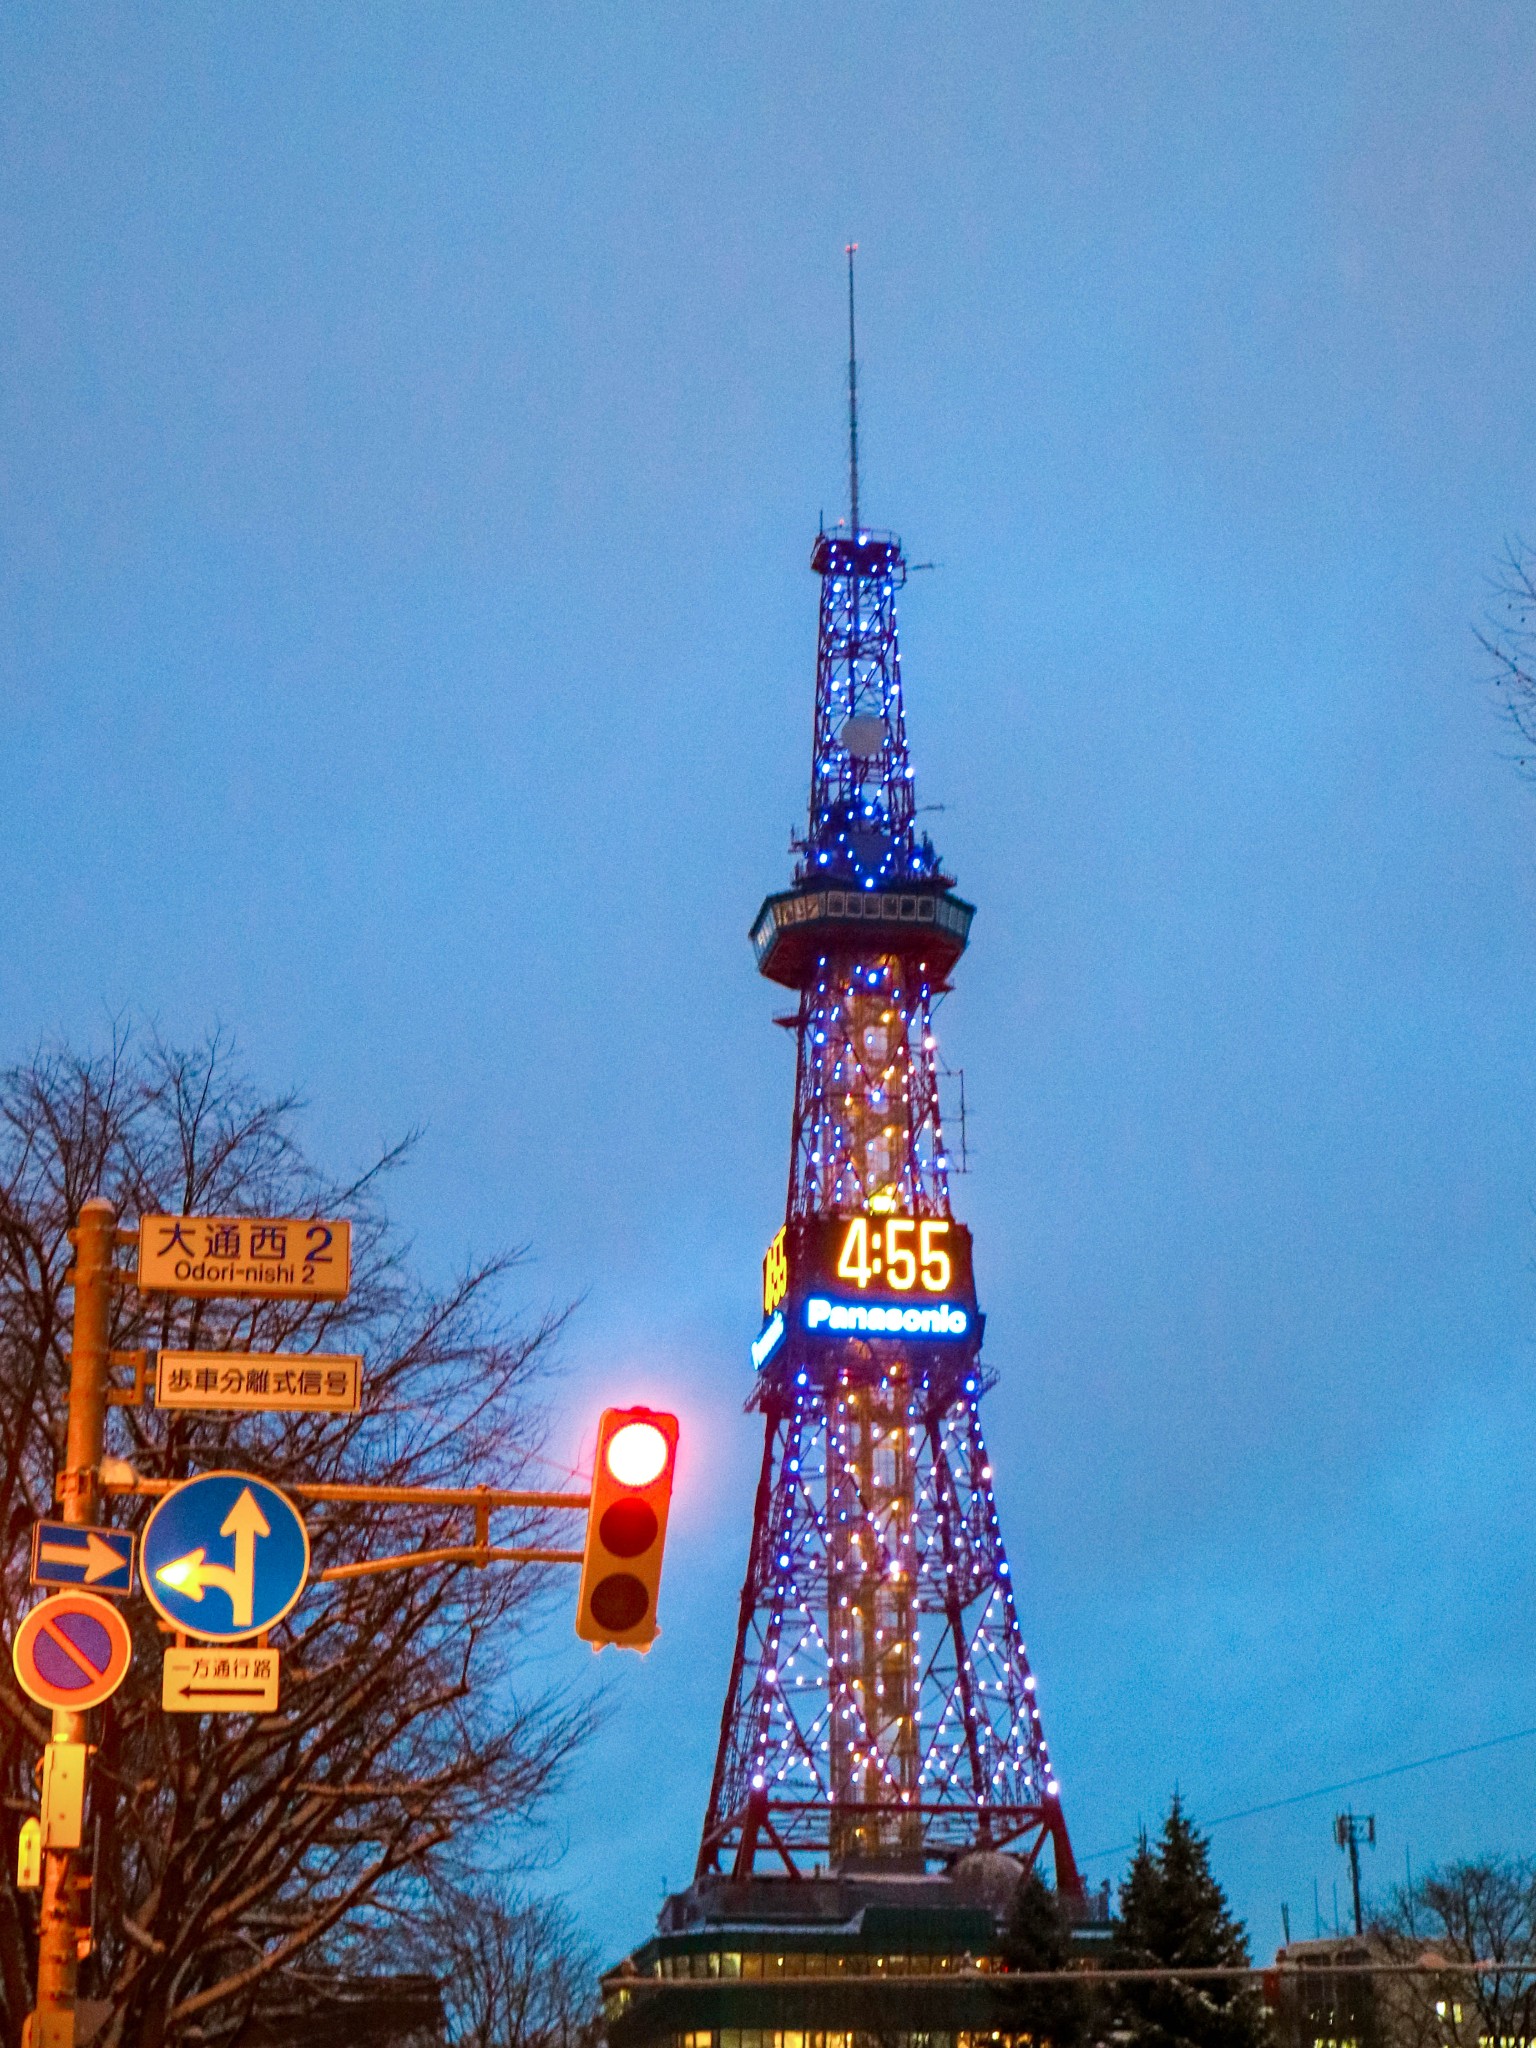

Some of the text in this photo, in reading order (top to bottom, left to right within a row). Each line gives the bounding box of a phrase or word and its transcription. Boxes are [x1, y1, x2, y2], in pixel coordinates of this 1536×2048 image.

[838, 1218, 950, 1291] 4:55
[174, 1261, 315, 1284] Odori-nishi 2
[808, 1299, 966, 1333] Panasonic
[168, 1368, 348, 1396] 歩車分離式信号
[172, 1658, 271, 1679] 一方通行路
